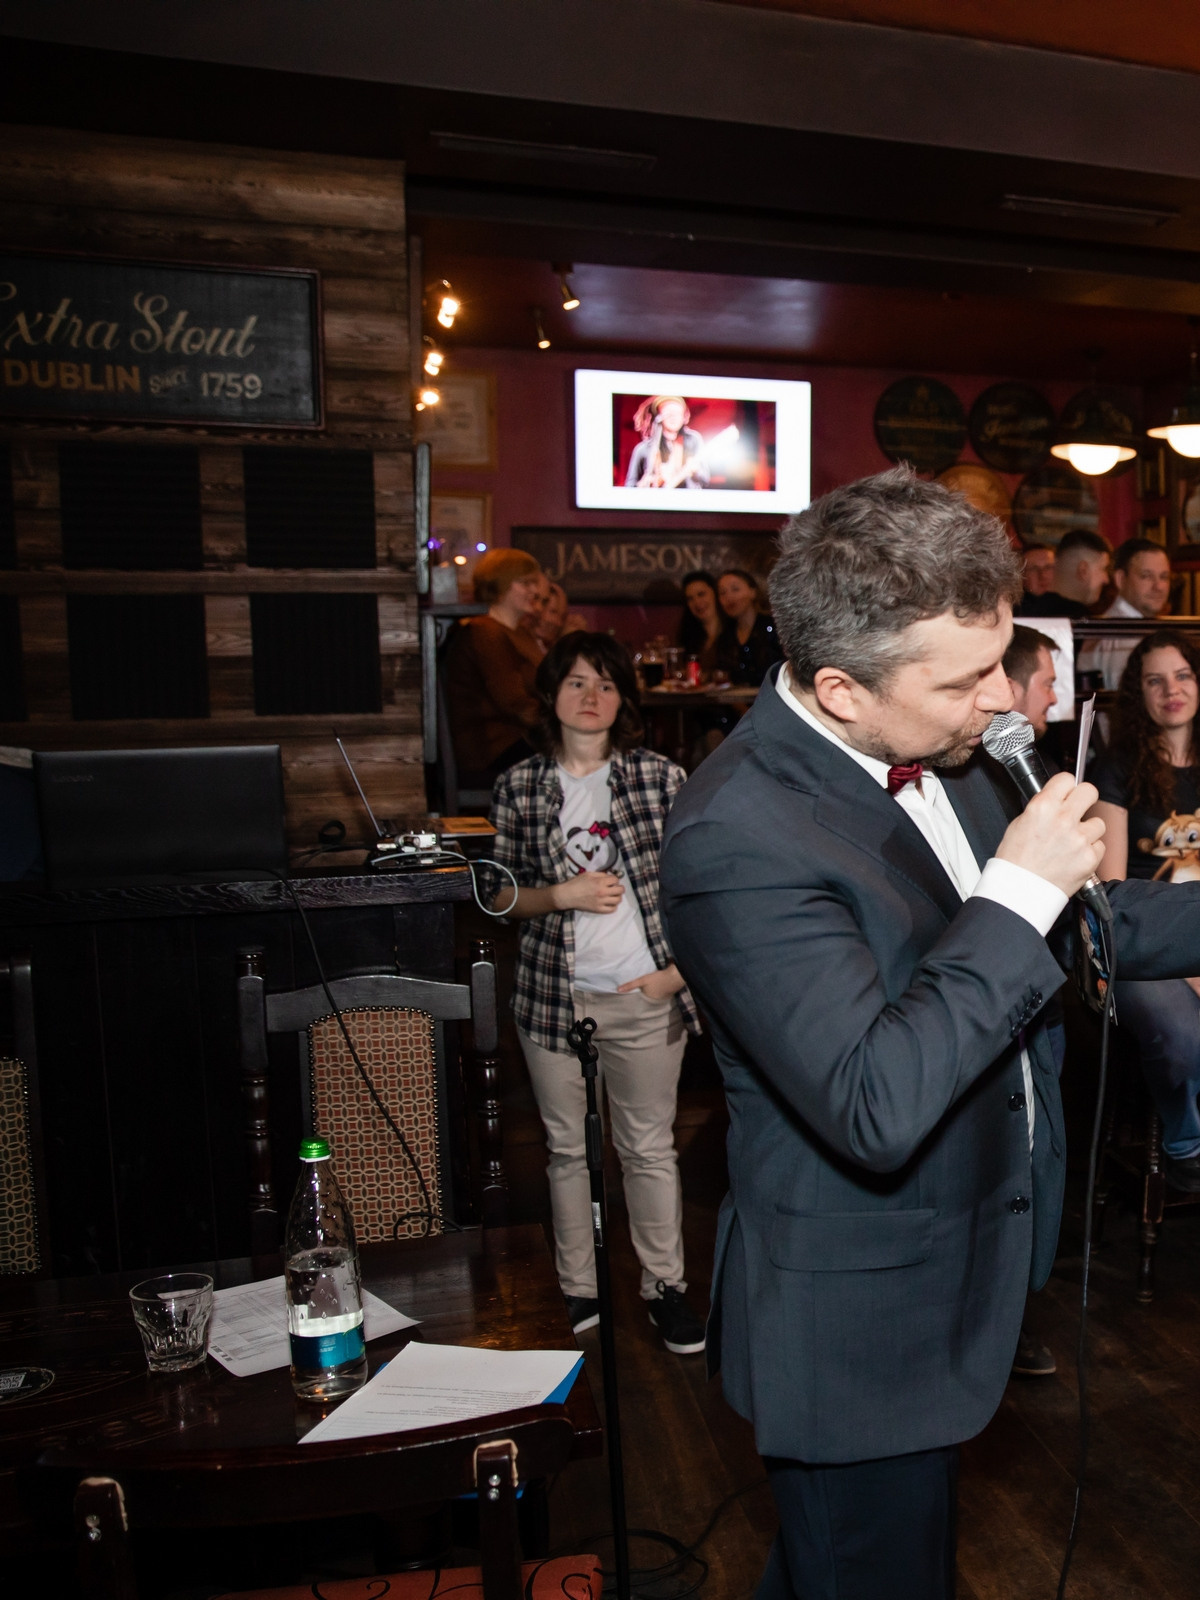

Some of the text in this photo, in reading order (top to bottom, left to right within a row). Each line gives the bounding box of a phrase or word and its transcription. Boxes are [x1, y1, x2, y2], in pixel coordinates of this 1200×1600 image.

[130, 291, 259, 358] Stout
[3, 358, 142, 394] DUBLIN
[201, 371, 263, 399] 1759
[545, 542, 704, 580] JAMESON
